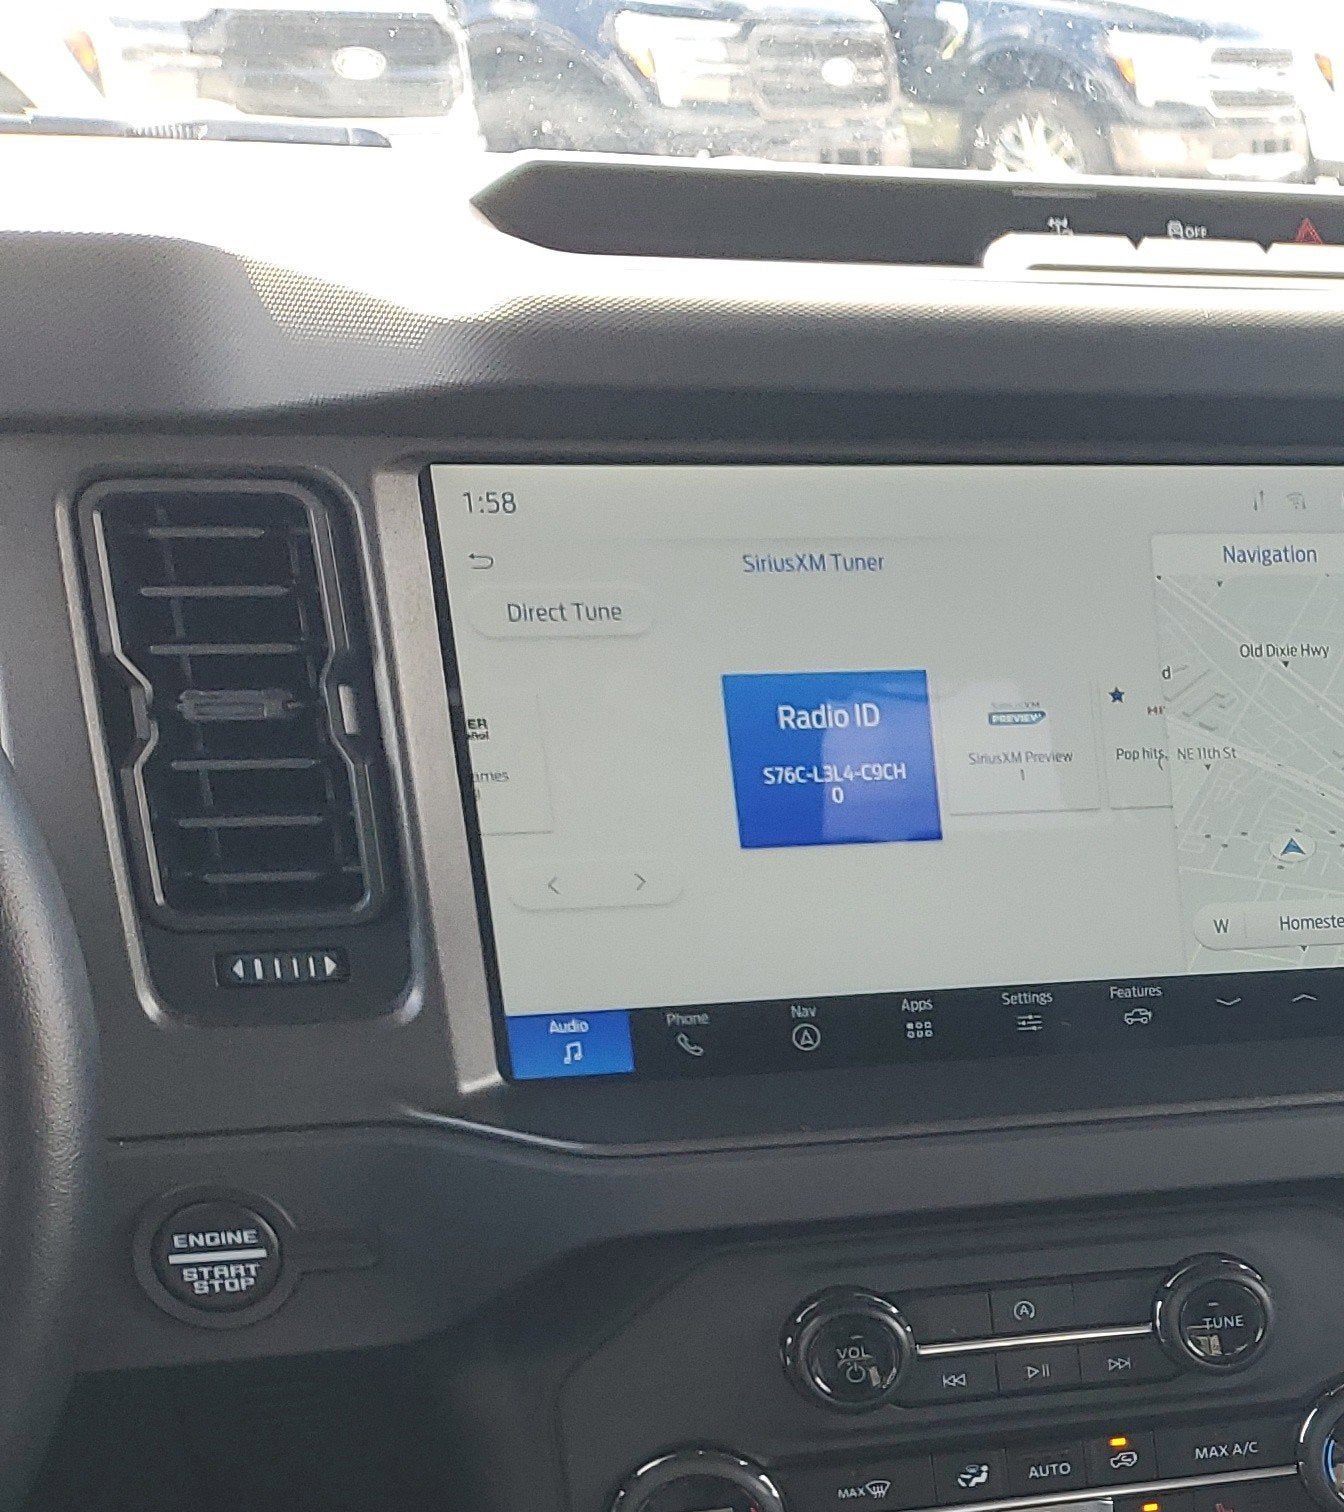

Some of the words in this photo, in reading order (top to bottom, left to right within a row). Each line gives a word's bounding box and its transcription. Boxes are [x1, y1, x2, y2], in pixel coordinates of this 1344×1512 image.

[461, 490, 517, 515] 1:58
[742, 553, 827, 573] SiriusXM
[830, 554, 885, 572] Tuner
[1223, 545, 1318, 566] Navigation
[506, 602, 567, 623] Direct
[571, 602, 622, 622] Tune
[1239, 643, 1264, 659] Old
[1266, 643, 1298, 658] Dixie
[1301, 643, 1330, 661] Hwy
[777, 703, 848, 731] Radio
[854, 703, 880, 728] ID
[968, 751, 1021, 765] SiriusXM
[1025, 750, 1073, 763] Preview
[1116, 748, 1139, 762] Pop
[1177, 748, 1194, 760] NE
[1197, 747, 1220, 760] 11th
[1223, 746, 1237, 759] St
[1213, 918, 1230, 935] W
[1001, 989, 1053, 1007] Settings
[1109, 984, 1162, 999] Features
[791, 1004, 817, 1018] Nav
[902, 997, 934, 1014] Apps
[548, 1018, 589, 1035] Audio
[666, 1011, 710, 1027] Phone
[173, 1229, 259, 1249] ENGINE
[182, 1262, 260, 1282] START
[193, 1277, 255, 1295] STOP
[1202, 1314, 1245, 1330] TUNE
[836, 1344, 874, 1359] VOL
[1194, 1444, 1228, 1461] MAX
[1232, 1440, 1259, 1458] A/C
[1028, 1462, 1071, 1480] AUTO
[838, 1488, 866, 1500] MAX
